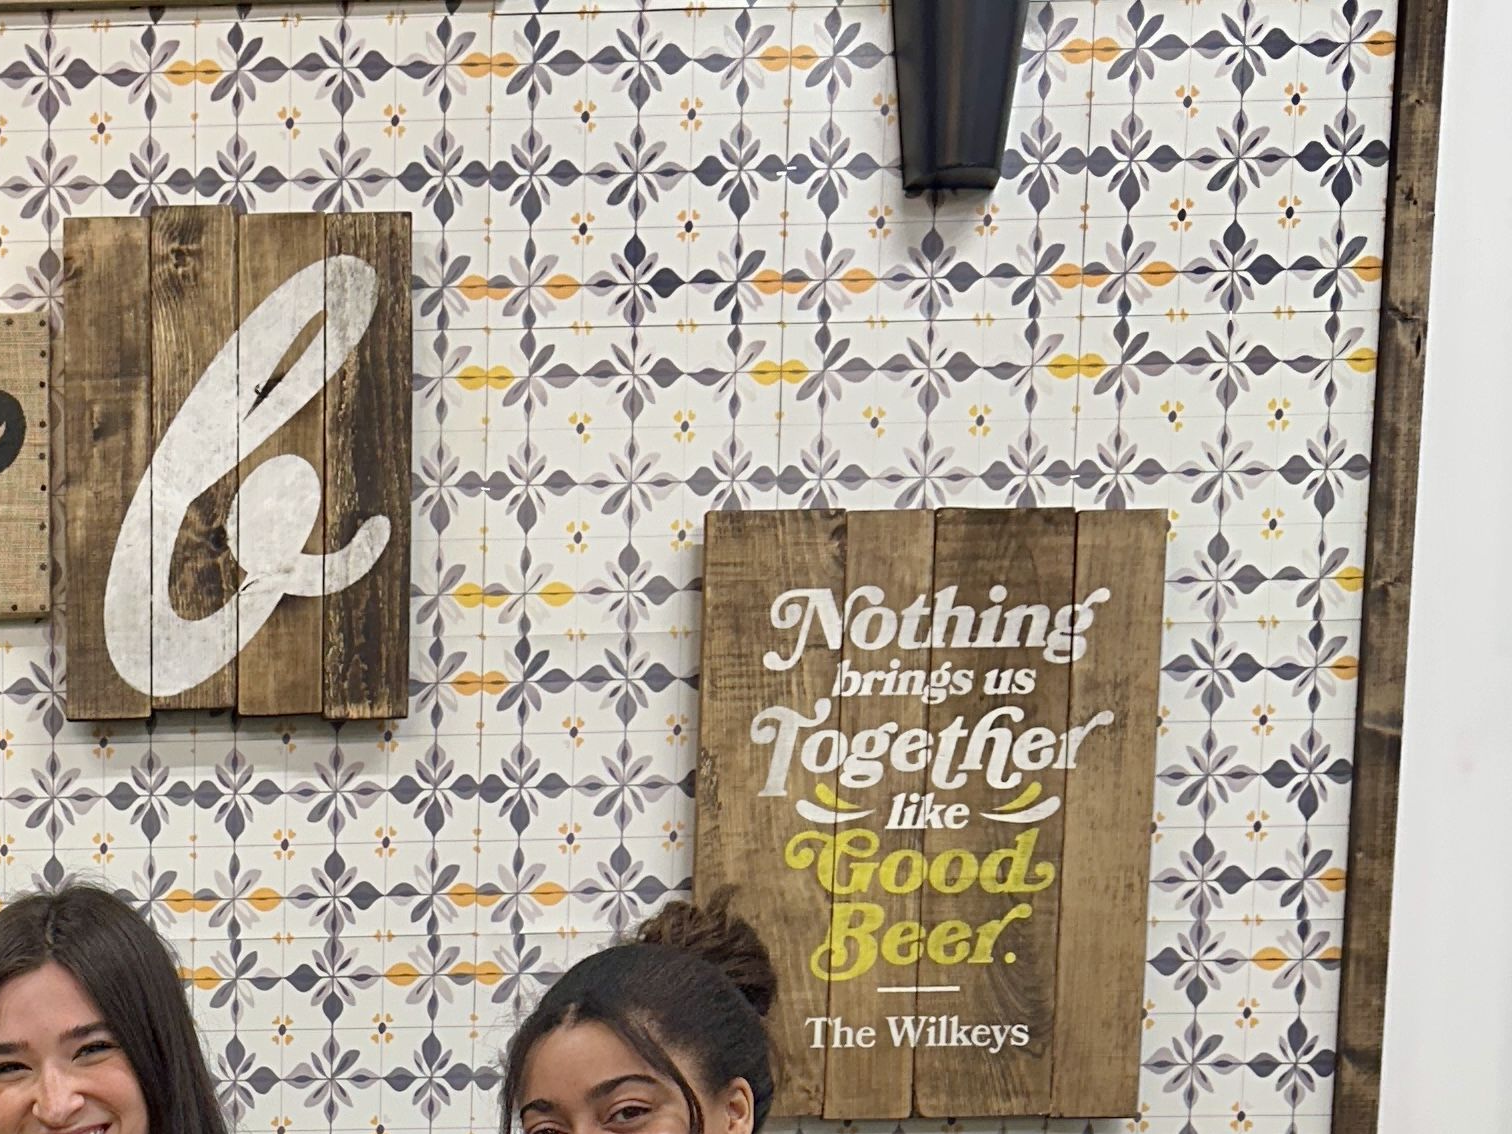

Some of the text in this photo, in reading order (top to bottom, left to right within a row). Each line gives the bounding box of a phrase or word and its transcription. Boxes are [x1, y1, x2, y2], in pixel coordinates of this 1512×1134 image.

[763, 584, 1111, 671] Nothing
[831, 658, 1037, 705] brings us
[750, 698, 1115, 797] Together
[884, 792, 970, 829] like
[784, 827, 1056, 895] Good
[810, 901, 1033, 981] Beer.
[804, 1014, 1030, 1054] The Wilkeys
